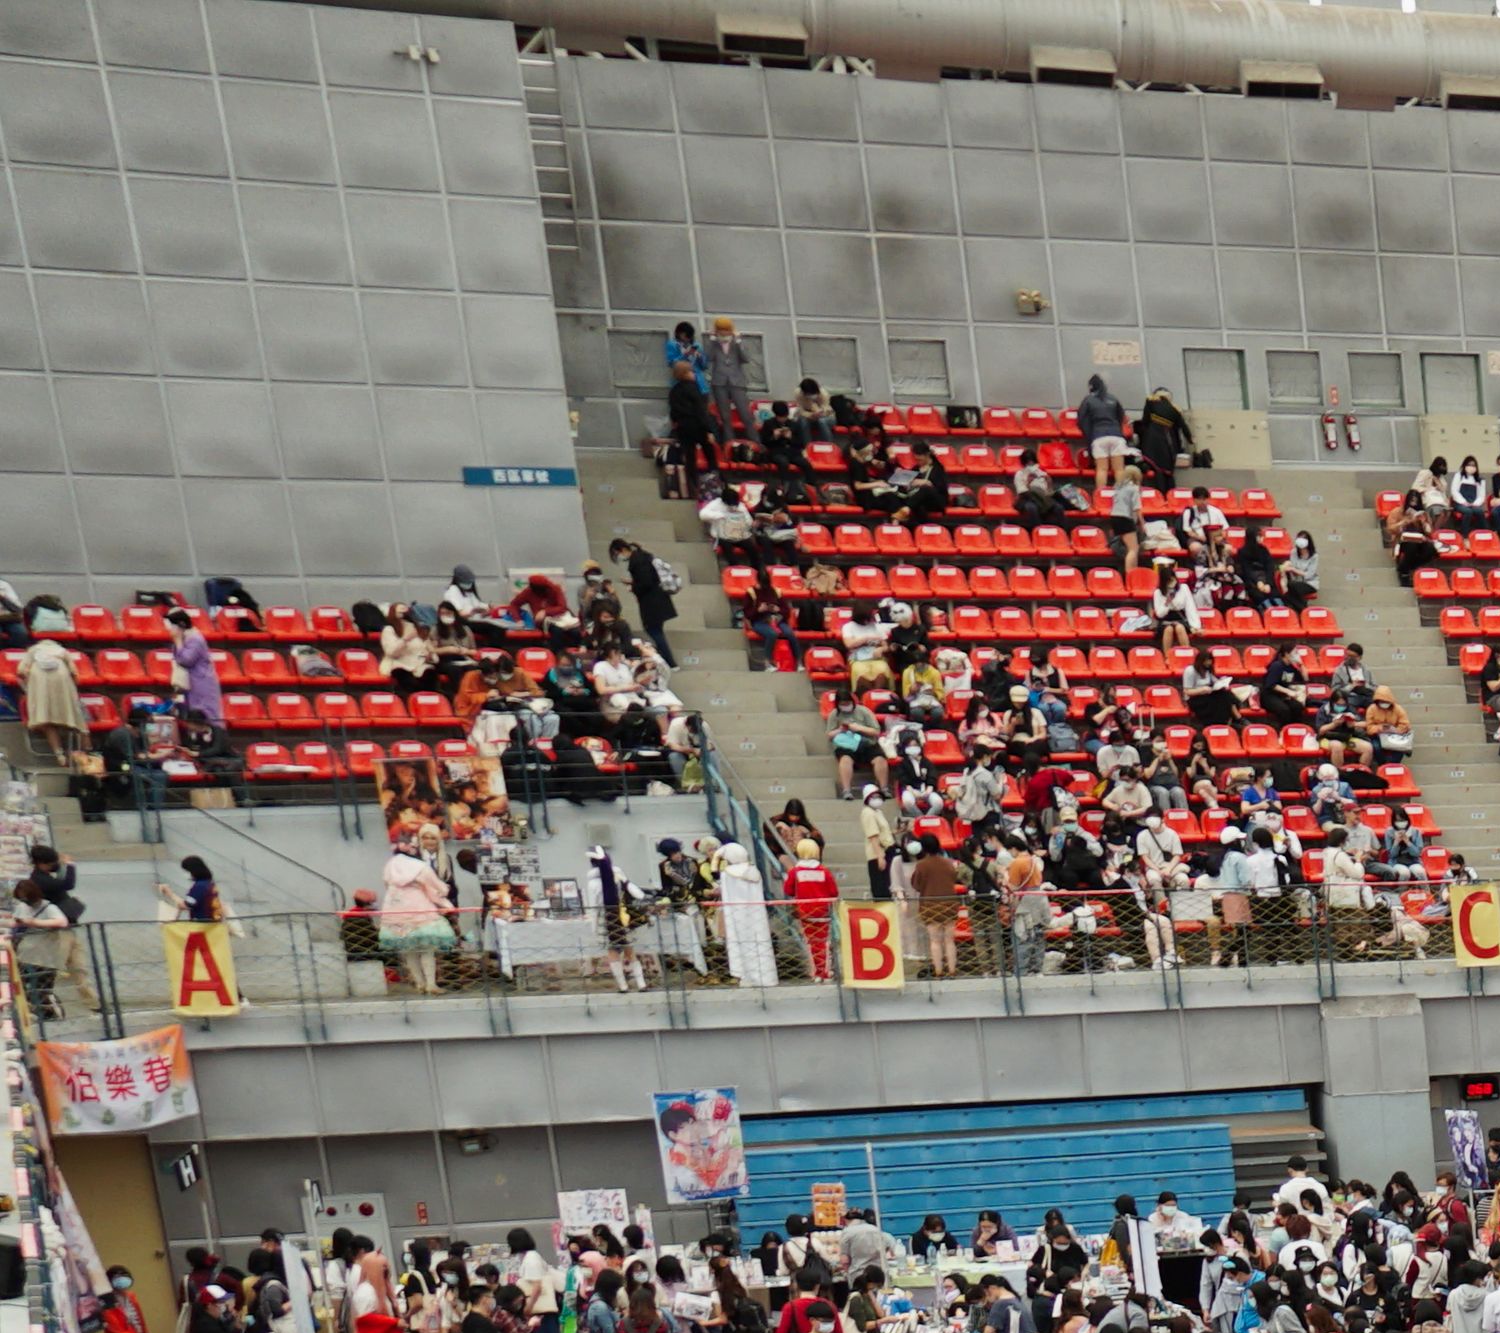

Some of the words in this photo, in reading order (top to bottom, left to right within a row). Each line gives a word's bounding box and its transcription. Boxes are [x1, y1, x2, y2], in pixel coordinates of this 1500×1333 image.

[847, 908, 895, 981] B
[1459, 891, 1500, 959] C
[179, 931, 234, 1007] A
[66, 1055, 172, 1104] 伯樂巷
[180, 1154, 197, 1188] H
